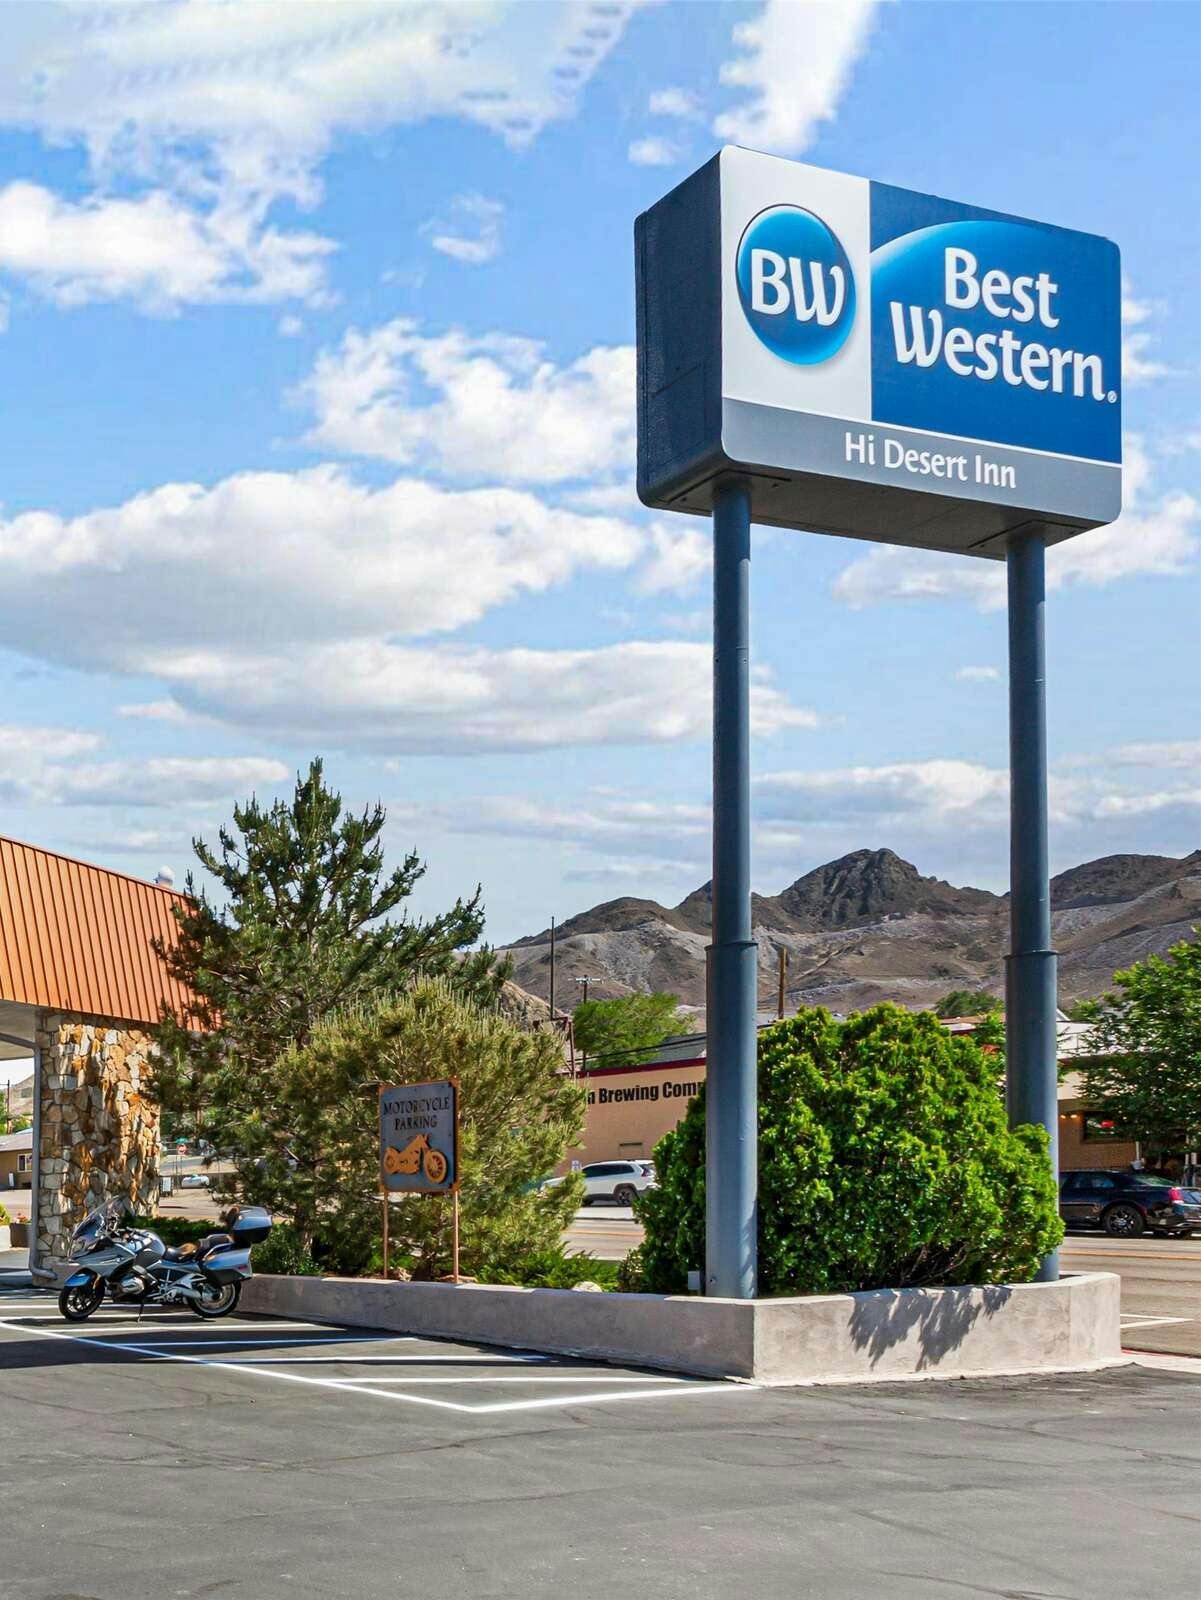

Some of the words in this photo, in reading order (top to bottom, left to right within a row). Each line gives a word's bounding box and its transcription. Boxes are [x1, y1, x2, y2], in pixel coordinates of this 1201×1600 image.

[749, 248, 846, 327] BW
[944, 246, 1061, 329] Best
[844, 431, 876, 466] Hi
[883, 438, 969, 482] Desert
[974, 454, 1017, 489] Inn
[383, 1096, 450, 1115] MOTORCYCLE
[598, 1085, 659, 1104] Brewing
[394, 1115, 438, 1130] PARKING
